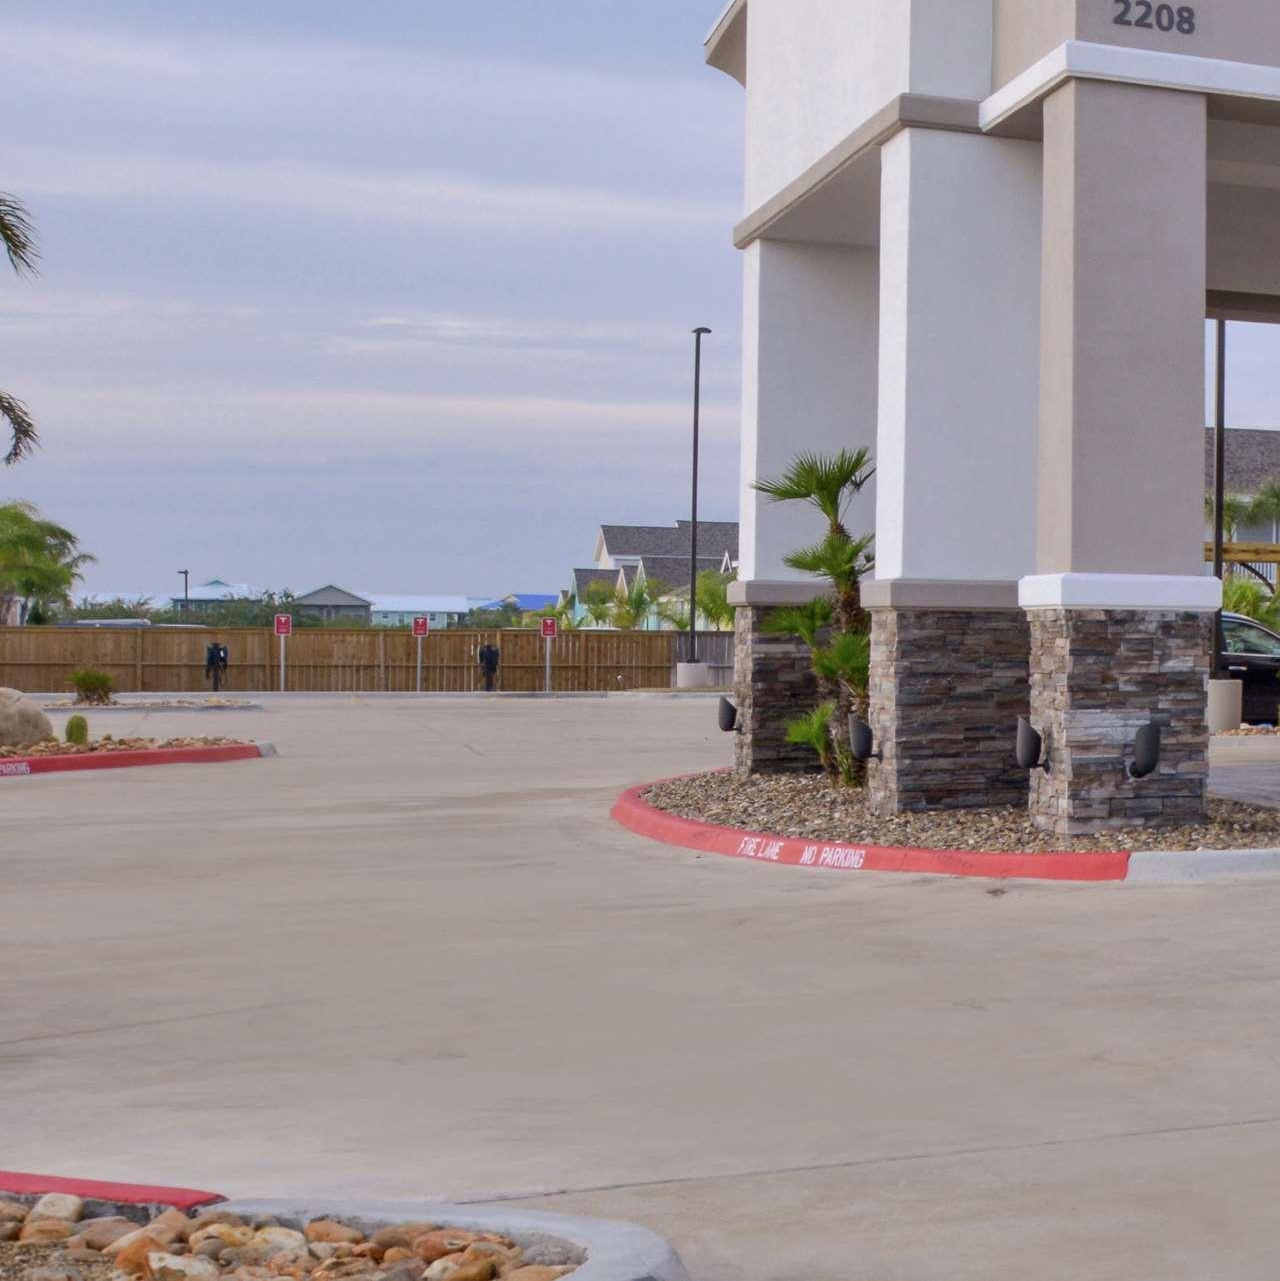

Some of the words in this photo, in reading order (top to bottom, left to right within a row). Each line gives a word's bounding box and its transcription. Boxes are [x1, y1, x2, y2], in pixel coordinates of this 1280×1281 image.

[737, 837, 761, 856] FIRE
[758, 839, 784, 860] LANE
[800, 845, 818, 865] NO
[819, 846, 866, 869] PARKING
